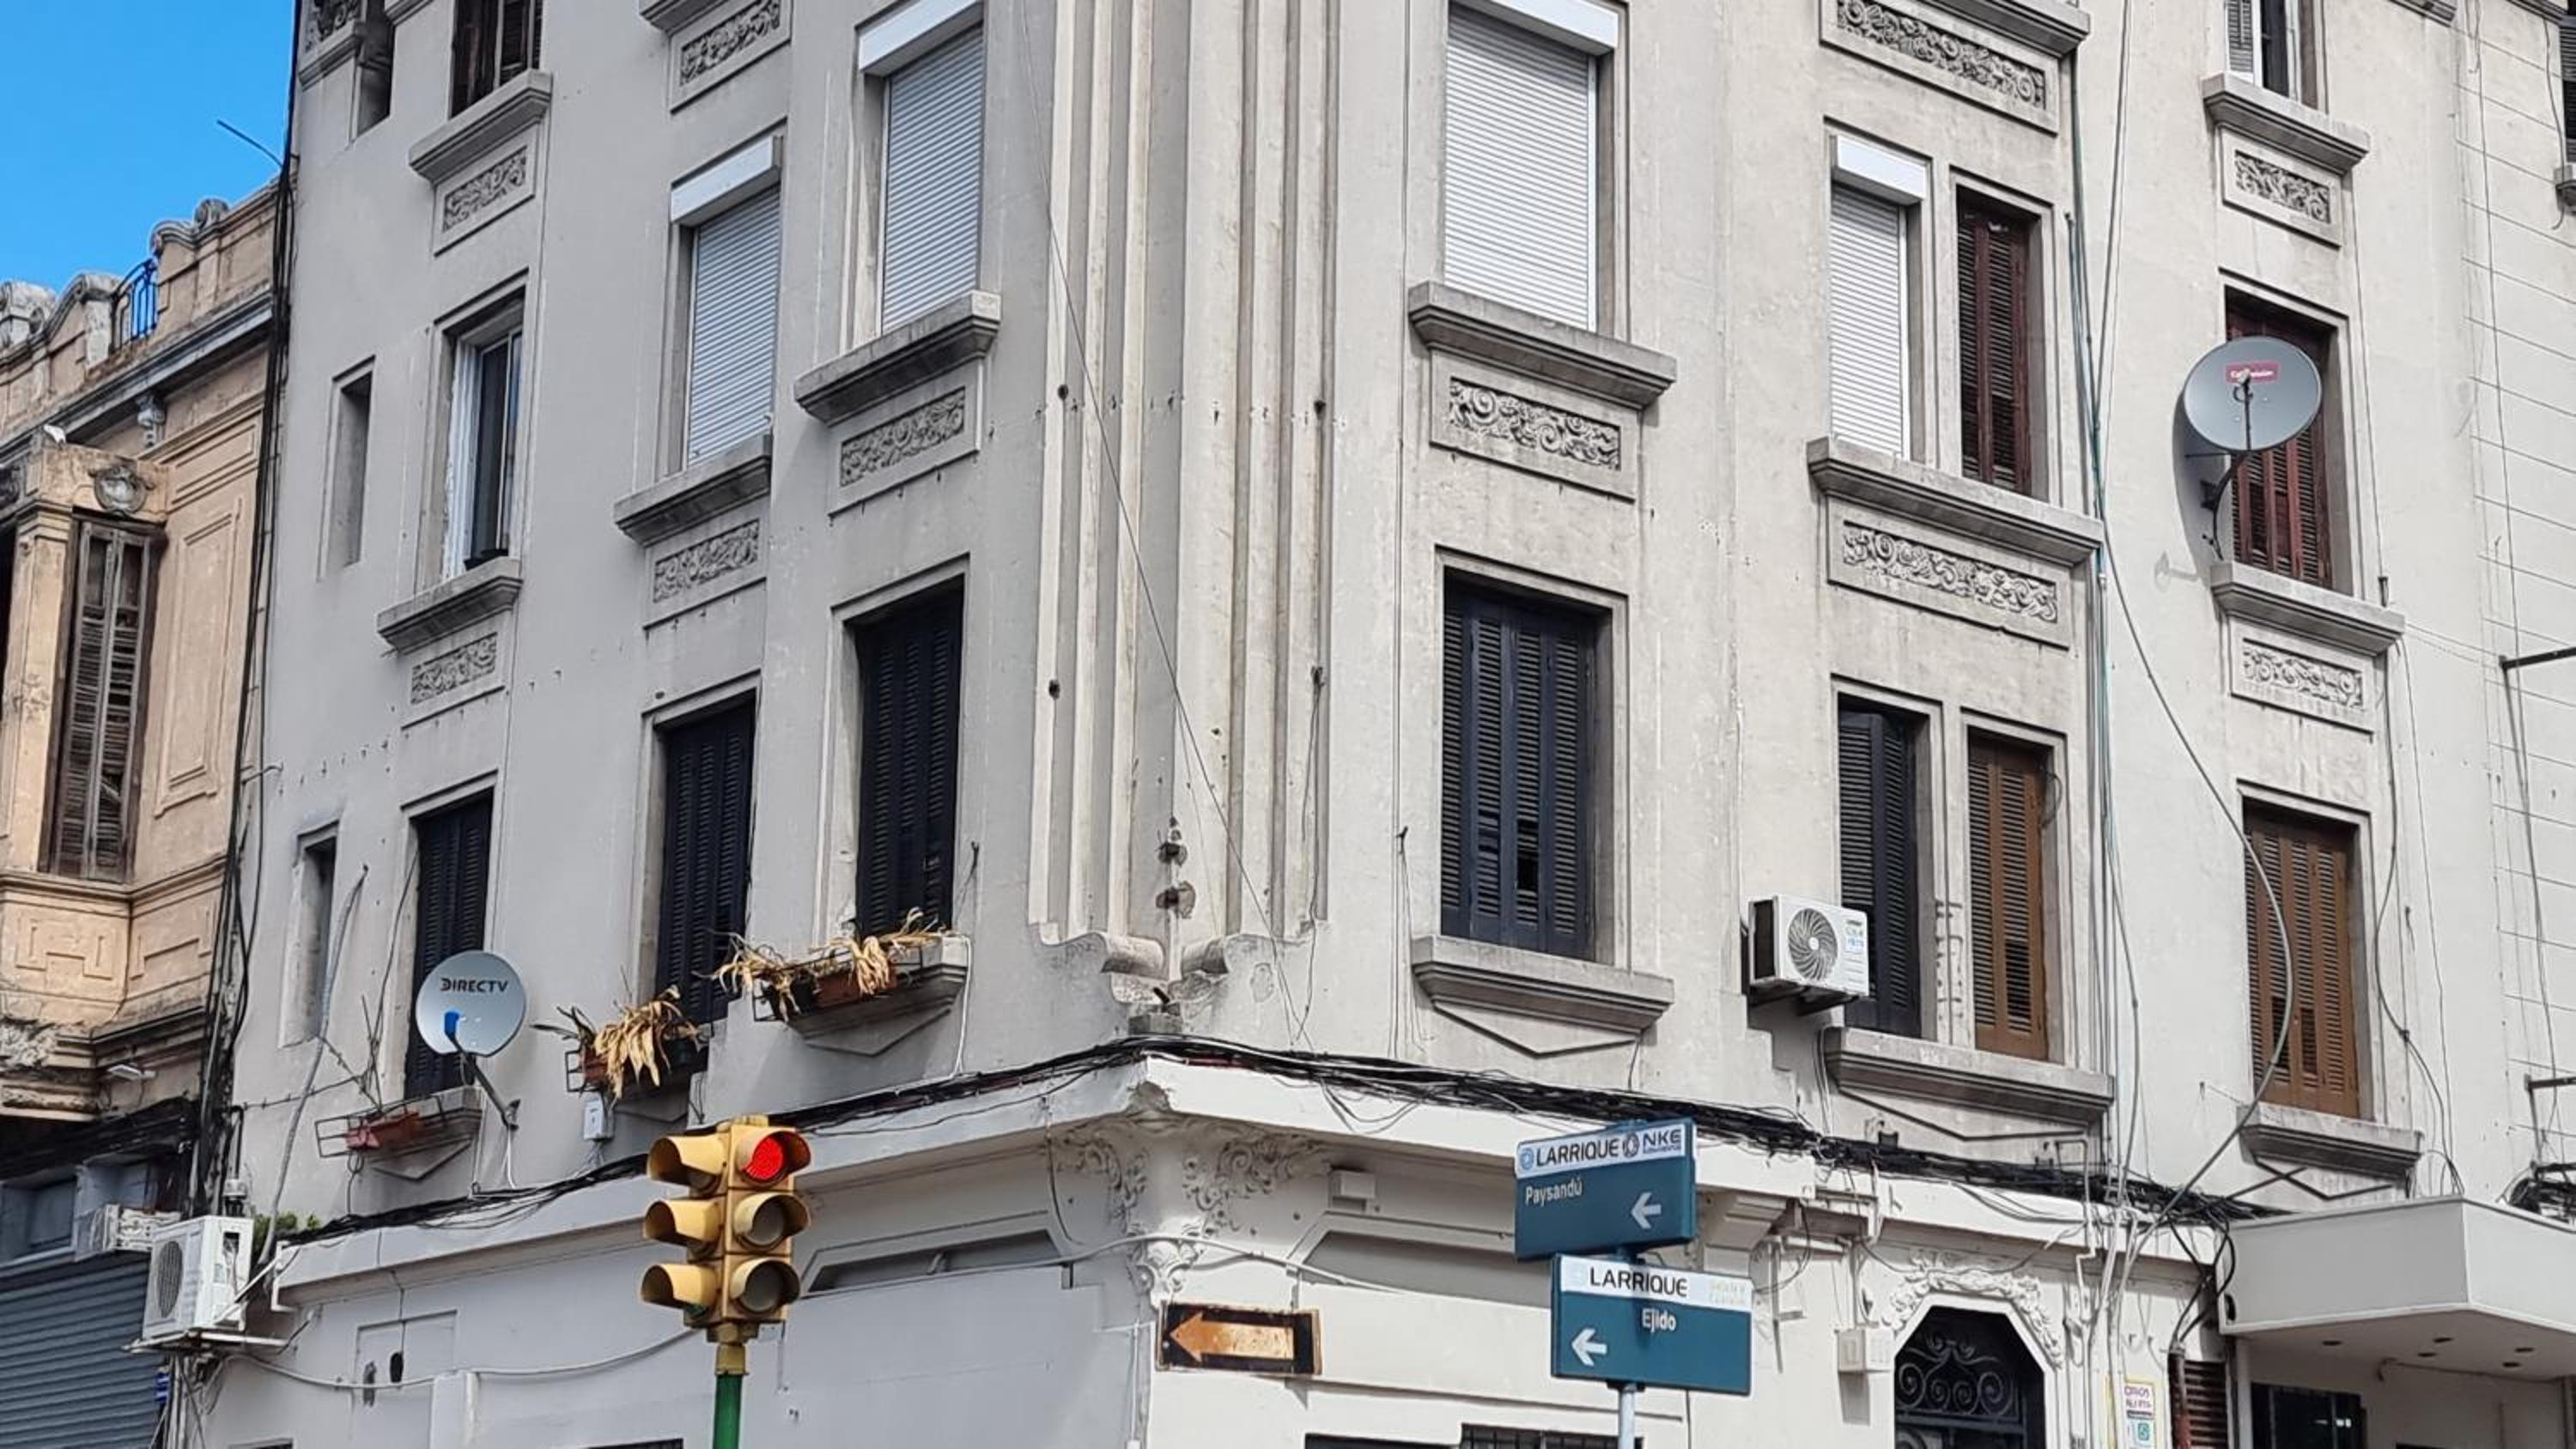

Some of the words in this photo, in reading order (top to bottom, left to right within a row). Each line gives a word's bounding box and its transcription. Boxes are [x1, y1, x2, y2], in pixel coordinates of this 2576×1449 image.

[440, 978, 508, 992] DIRECTV
[1536, 1137, 1619, 1167] LARRIQUE
[1643, 1128, 1682, 1147] NKE
[1525, 1176, 1583, 1206] Paysandú
[1590, 1267, 1688, 1297] LARRIQUE
[1642, 1307, 1676, 1333] Ejido
